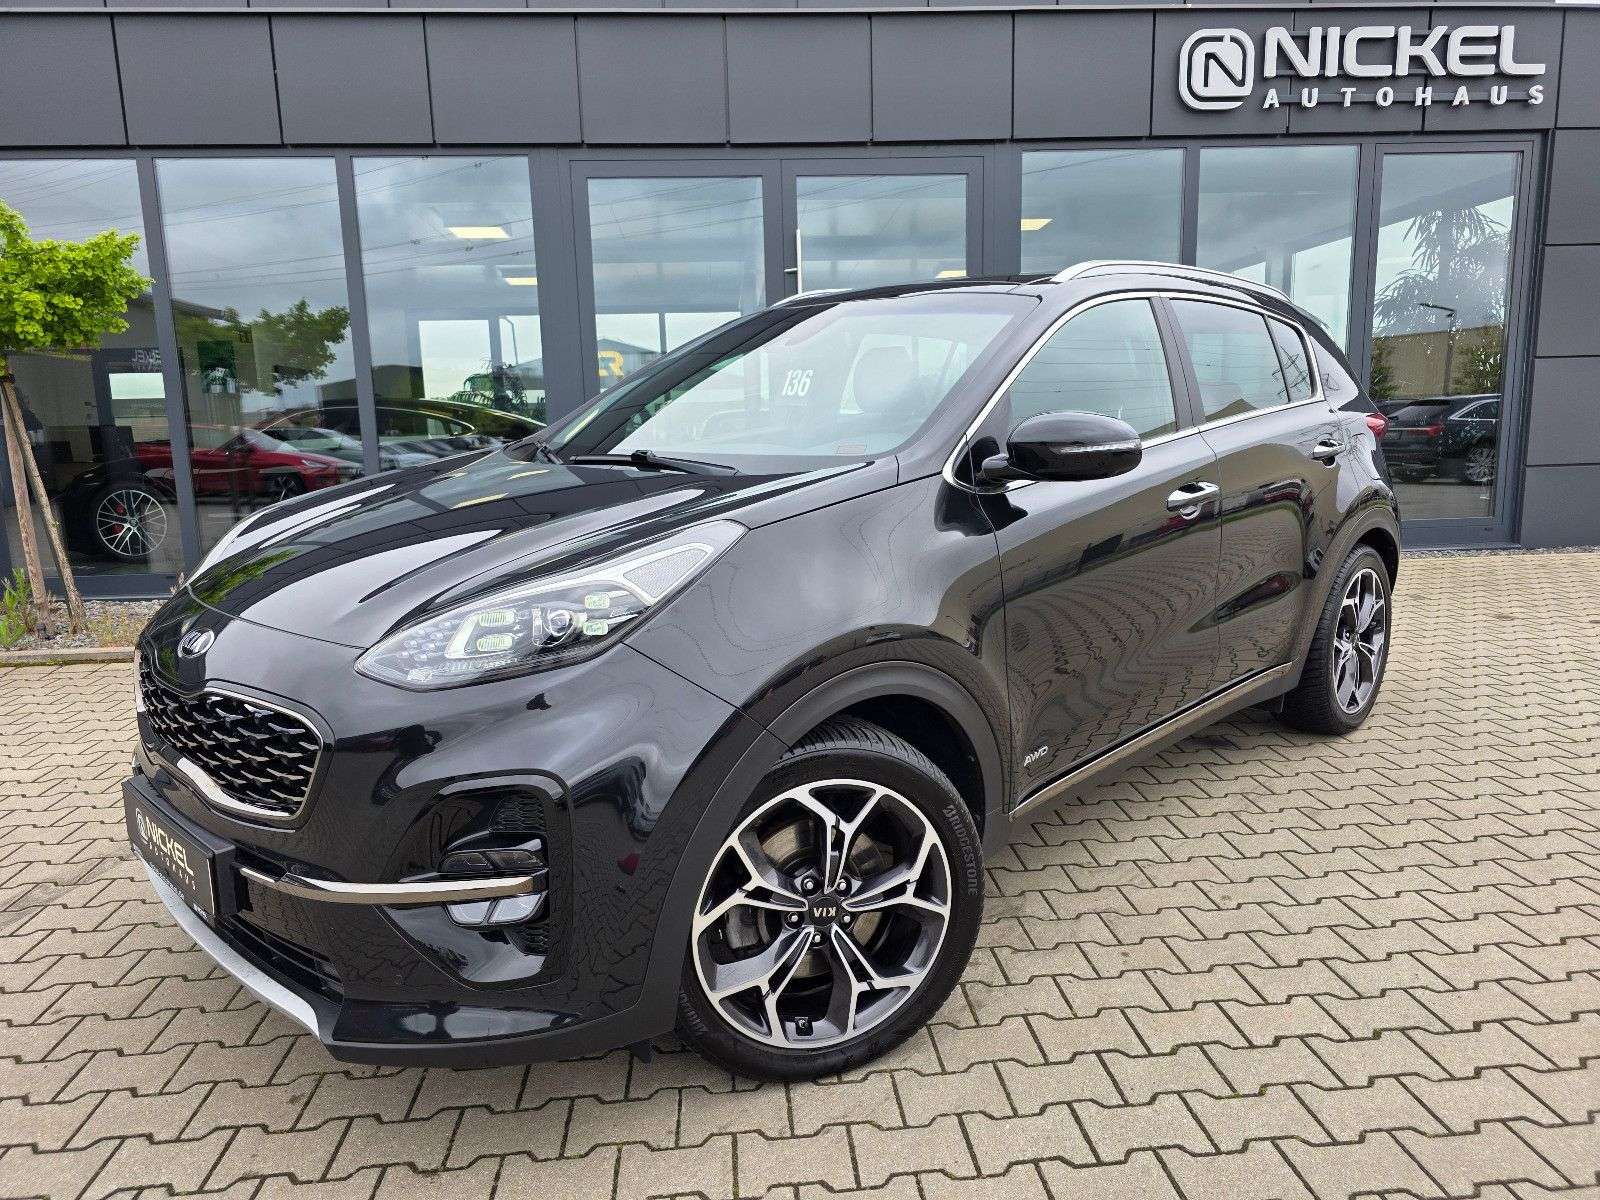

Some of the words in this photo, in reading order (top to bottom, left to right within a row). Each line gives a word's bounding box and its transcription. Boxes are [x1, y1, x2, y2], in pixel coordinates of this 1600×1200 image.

[1263, 25, 1546, 77] NICKEL
[1262, 85, 1545, 109] AUTOHAUS
[782, 369, 814, 397] 136
[1023, 745, 1049, 767] AWD
[145, 815, 194, 876] NICKEL
[813, 906, 837, 918] KIA
